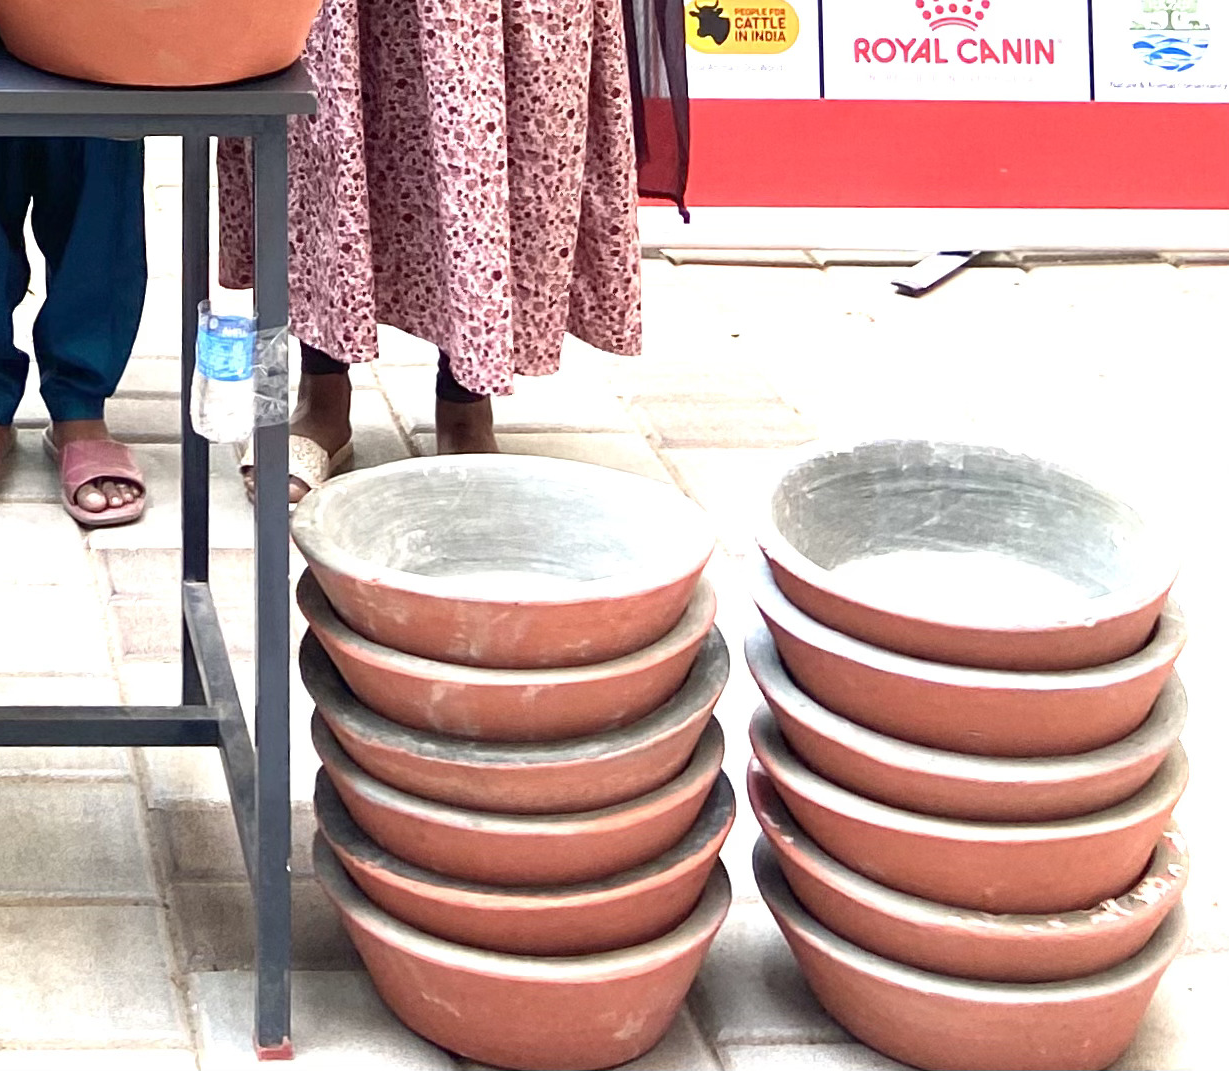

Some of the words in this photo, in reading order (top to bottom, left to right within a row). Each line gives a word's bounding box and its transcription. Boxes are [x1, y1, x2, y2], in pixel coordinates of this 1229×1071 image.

[734, 8, 767, 16] PEOPLE
[769, 8, 786, 16] FOR
[734, 17, 786, 29] CATTLE
[734, 31, 748, 42] IN
[751, 31, 786, 42] INDIA
[853, 37, 949, 64] ROYAL
[956, 38, 1055, 65] CANIN
